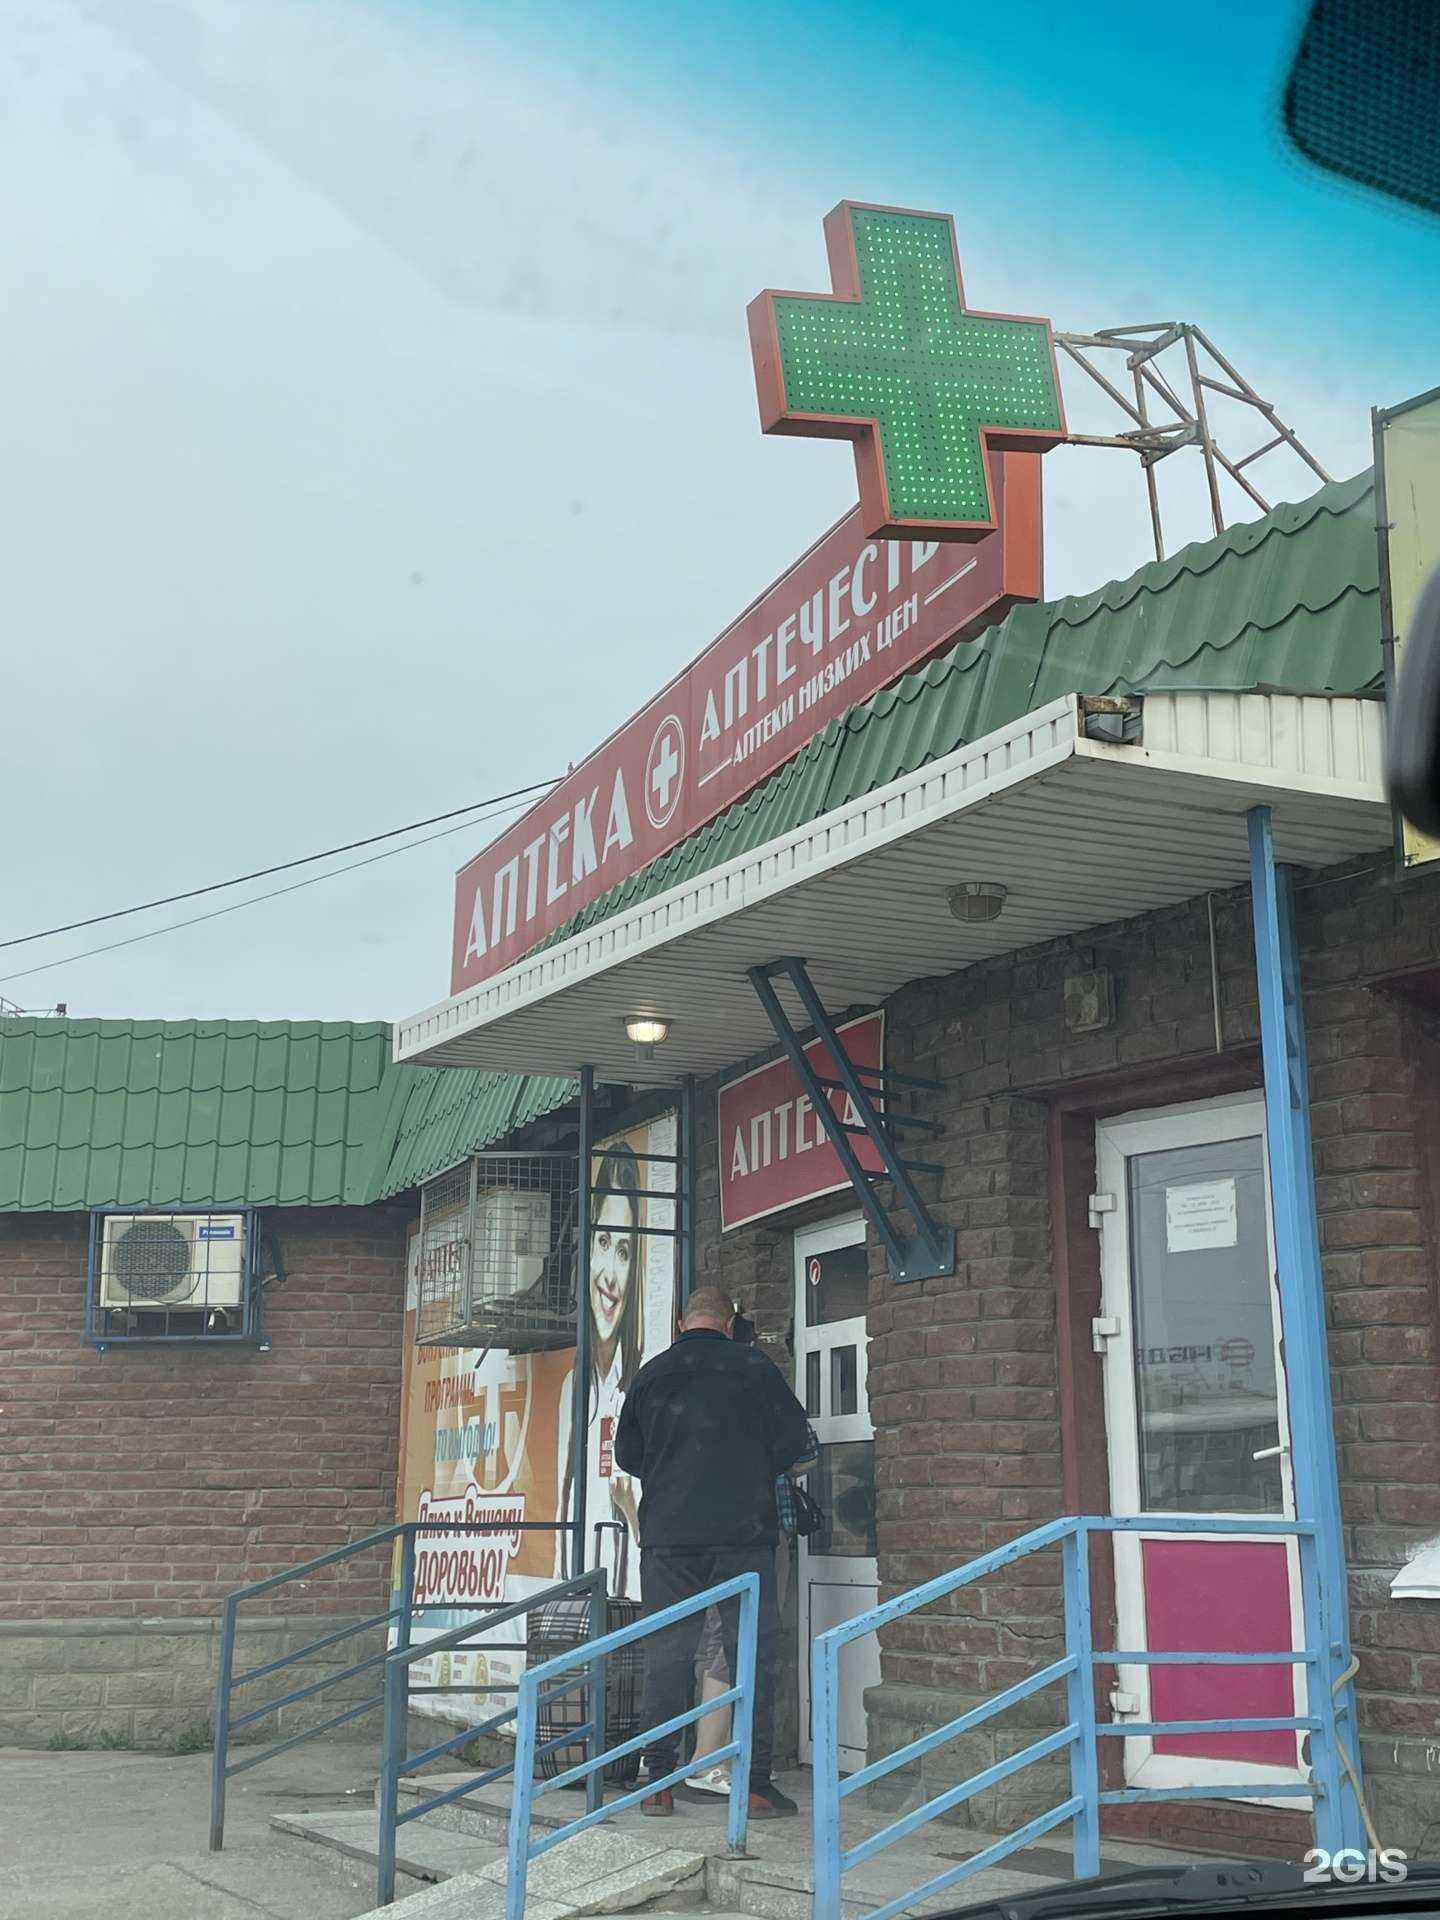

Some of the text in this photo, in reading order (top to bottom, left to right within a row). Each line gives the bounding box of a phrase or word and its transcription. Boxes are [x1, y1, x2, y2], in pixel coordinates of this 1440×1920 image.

[463, 540, 941, 968] АПТЕКА АПТЕЧЕСТ
[732, 592, 918, 767] АПТЕКИ НИЗКИХ ЦЕН
[412, 1548, 503, 1604] ДОРОВЬЮ!
